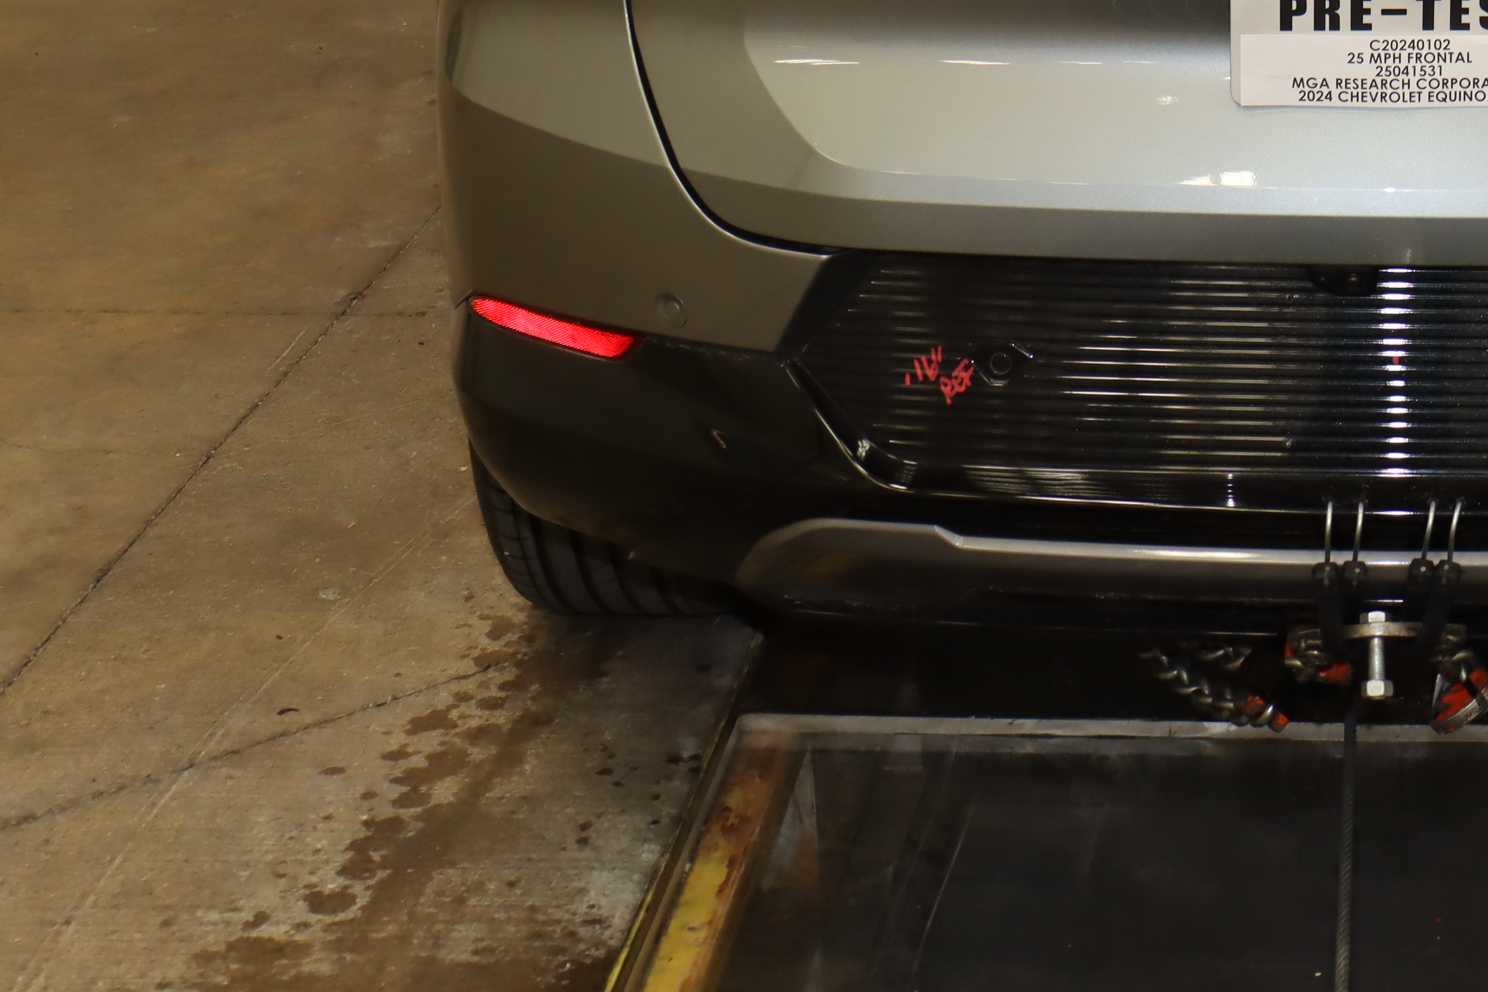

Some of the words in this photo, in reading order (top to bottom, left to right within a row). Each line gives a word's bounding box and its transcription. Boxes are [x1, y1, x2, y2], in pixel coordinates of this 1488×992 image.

[1369, 38, 1451, 52] C20240102
[1347, 51, 1364, 64] 25
[1369, 51, 1402, 64] MPH
[1407, 51, 1473, 64] FRONTAL
[1375, 65, 1443, 77] 25041531
[1292, 77, 1330, 90] MGA
[1335, 77, 1411, 90] RESEARCH
[1298, 90, 1333, 103] 2024
[1337, 90, 1423, 103] CHEVROLET
